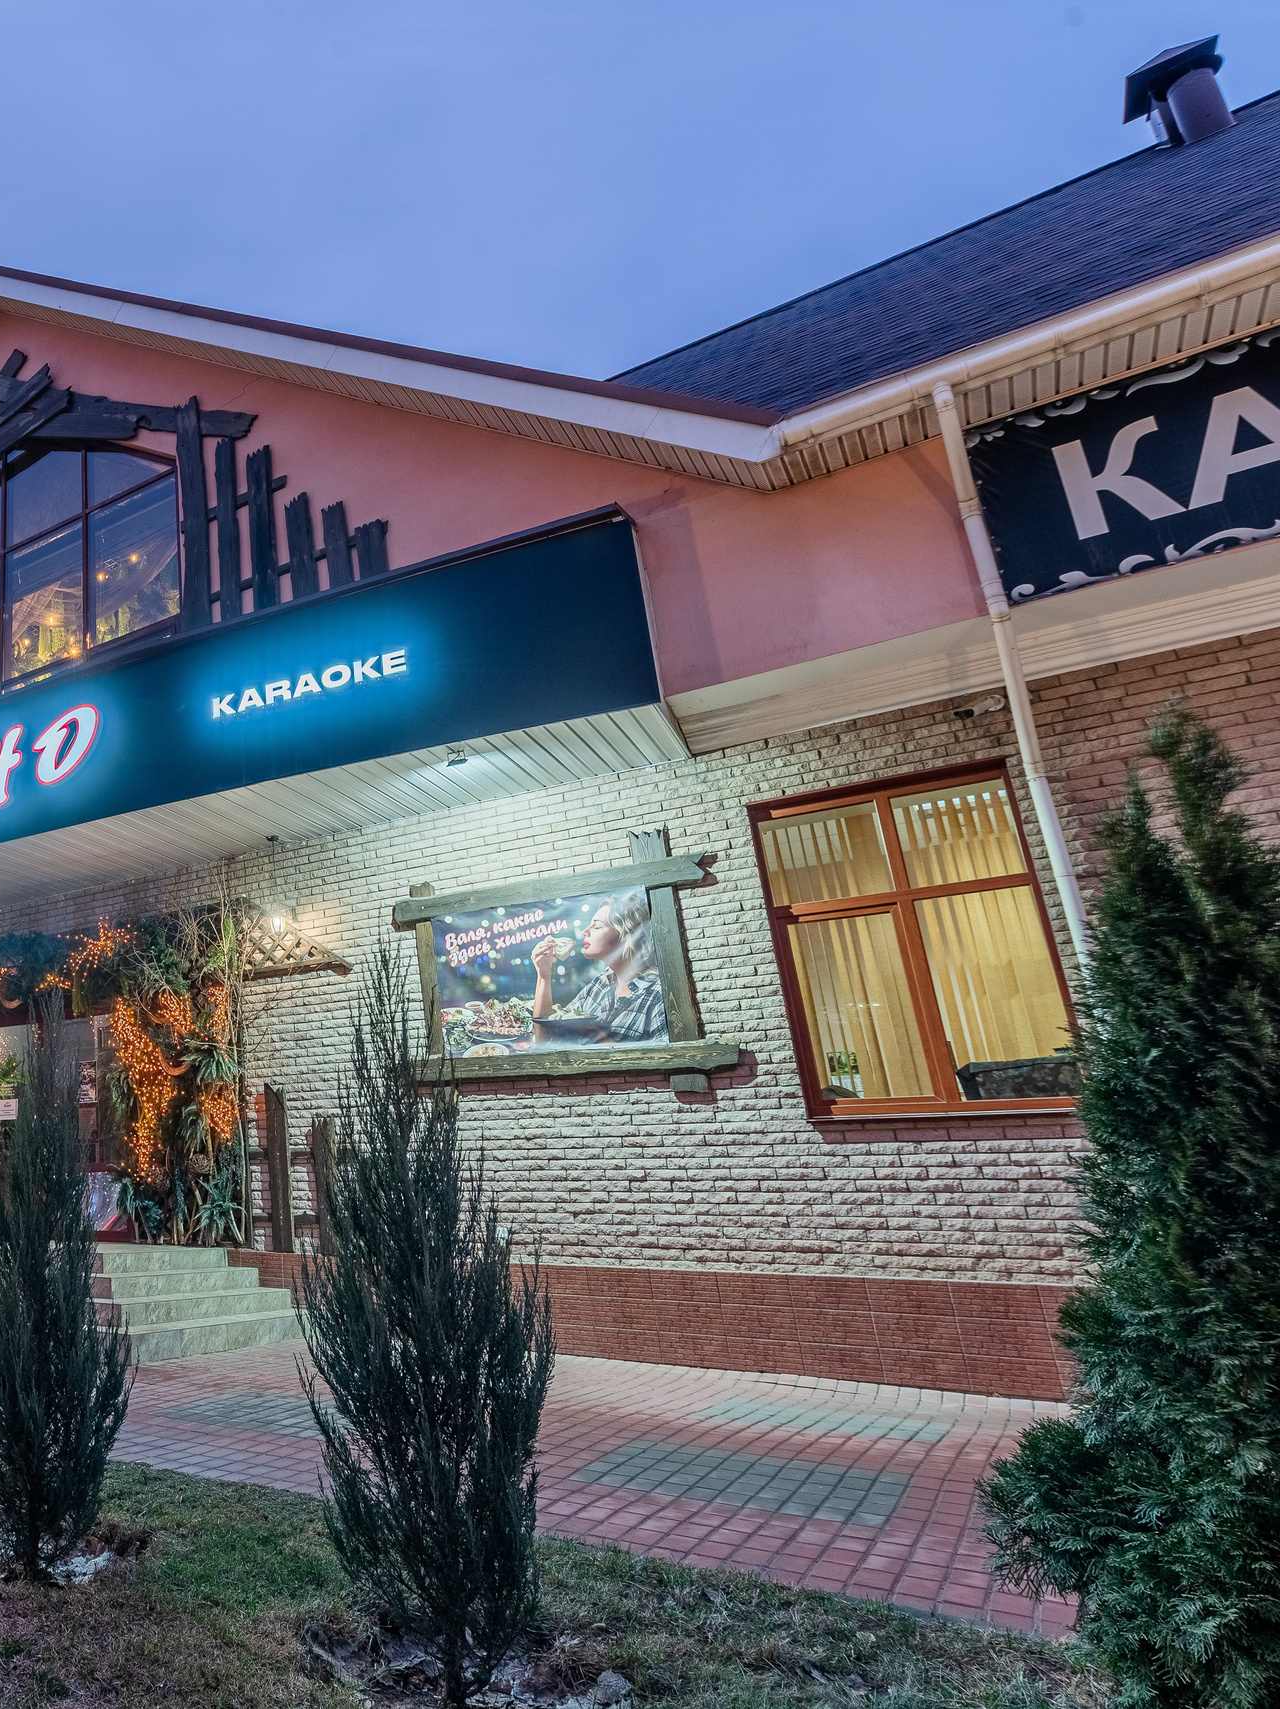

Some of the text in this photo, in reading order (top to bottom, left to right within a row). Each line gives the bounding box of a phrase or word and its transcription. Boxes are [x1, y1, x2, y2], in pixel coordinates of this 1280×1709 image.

[212, 649, 407, 718] KARAOKE
[445, 909, 544, 951] Валя, какие
[493, 920, 569, 949] хинкали
